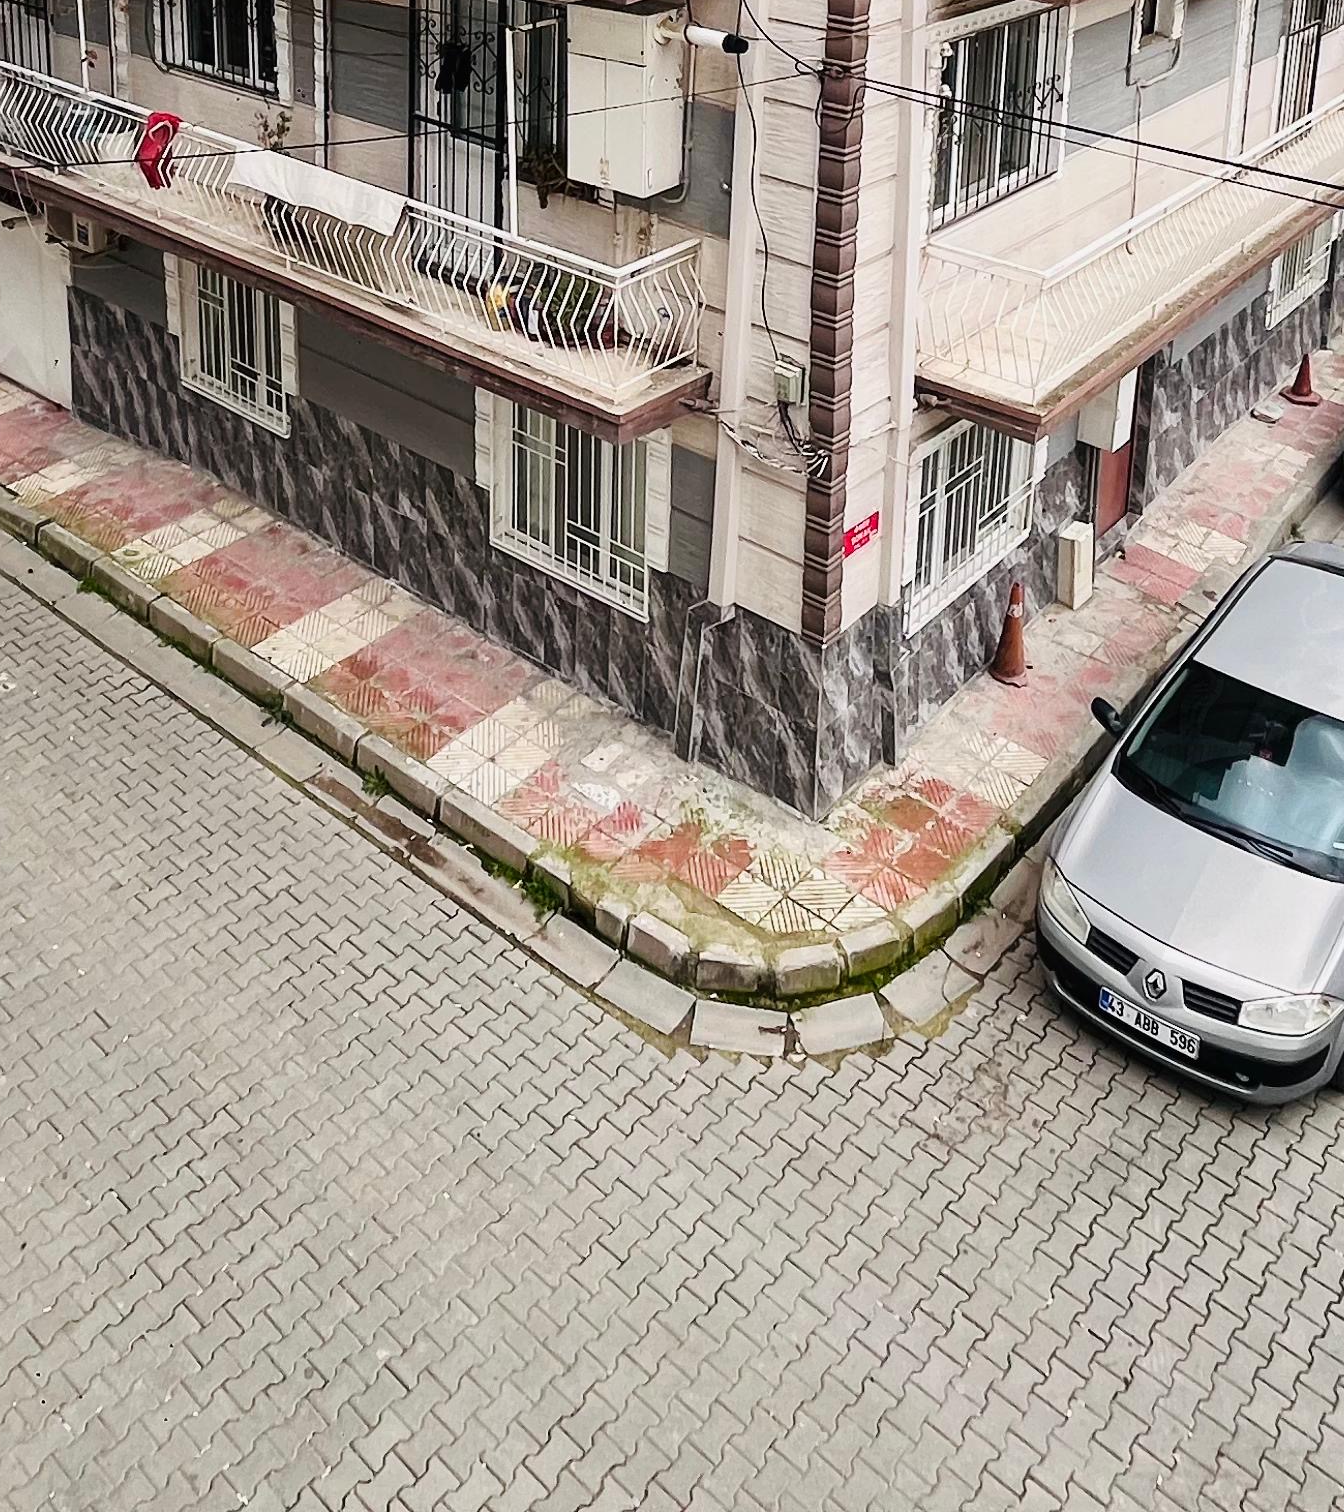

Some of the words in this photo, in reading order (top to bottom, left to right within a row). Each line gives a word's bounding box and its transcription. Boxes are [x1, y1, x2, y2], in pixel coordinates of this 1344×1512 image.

[1107, 994, 1125, 1016] 43
[1134, 1012, 1159, 1036] ABB
[1169, 1028, 1197, 1055] 596
